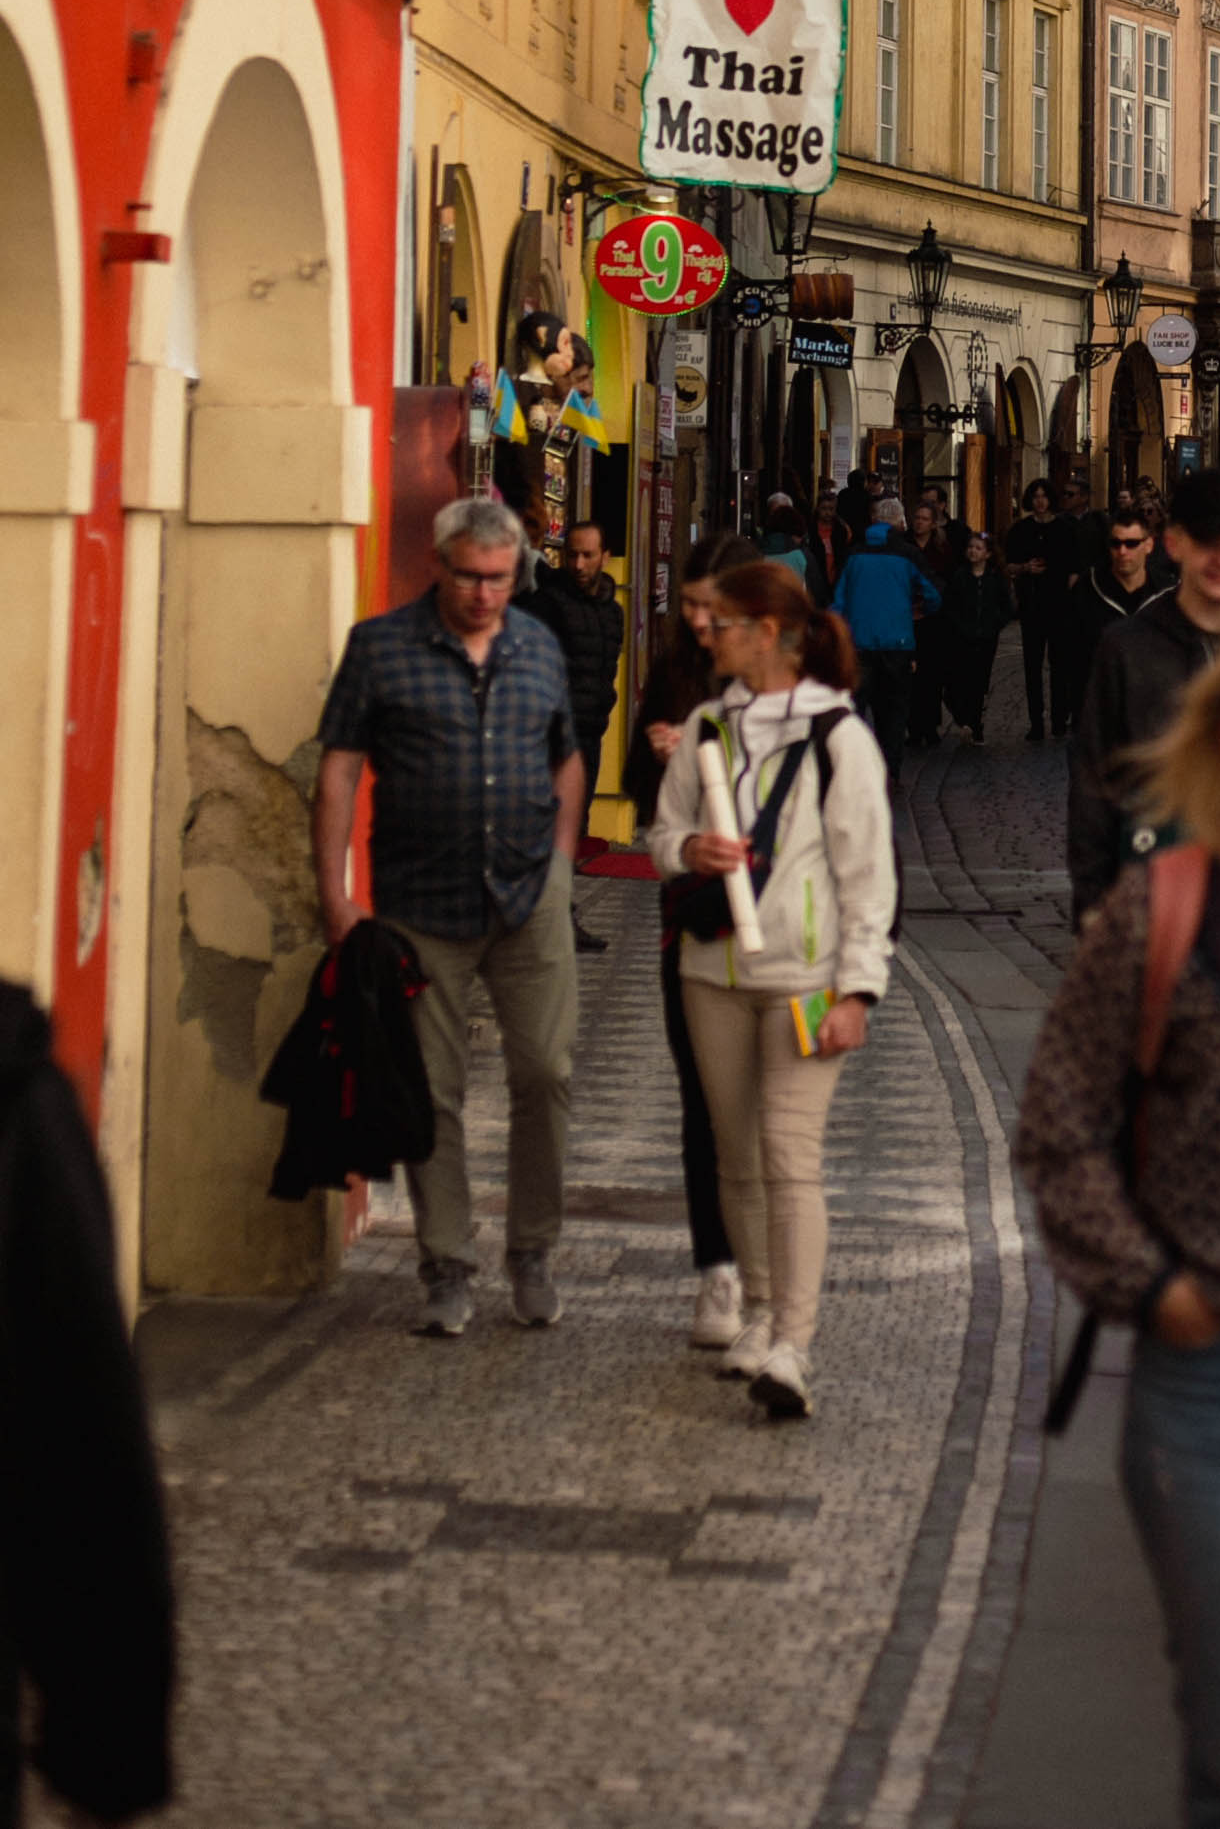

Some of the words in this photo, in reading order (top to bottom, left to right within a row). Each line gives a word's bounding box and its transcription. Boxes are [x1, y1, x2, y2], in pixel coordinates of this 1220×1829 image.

[683, 45, 804, 96] Thai
[655, 97, 823, 177] Massage
[640, 220, 683, 303] 9
[791, 350, 849, 365] Exchange
[794, 337, 849, 354] Market
